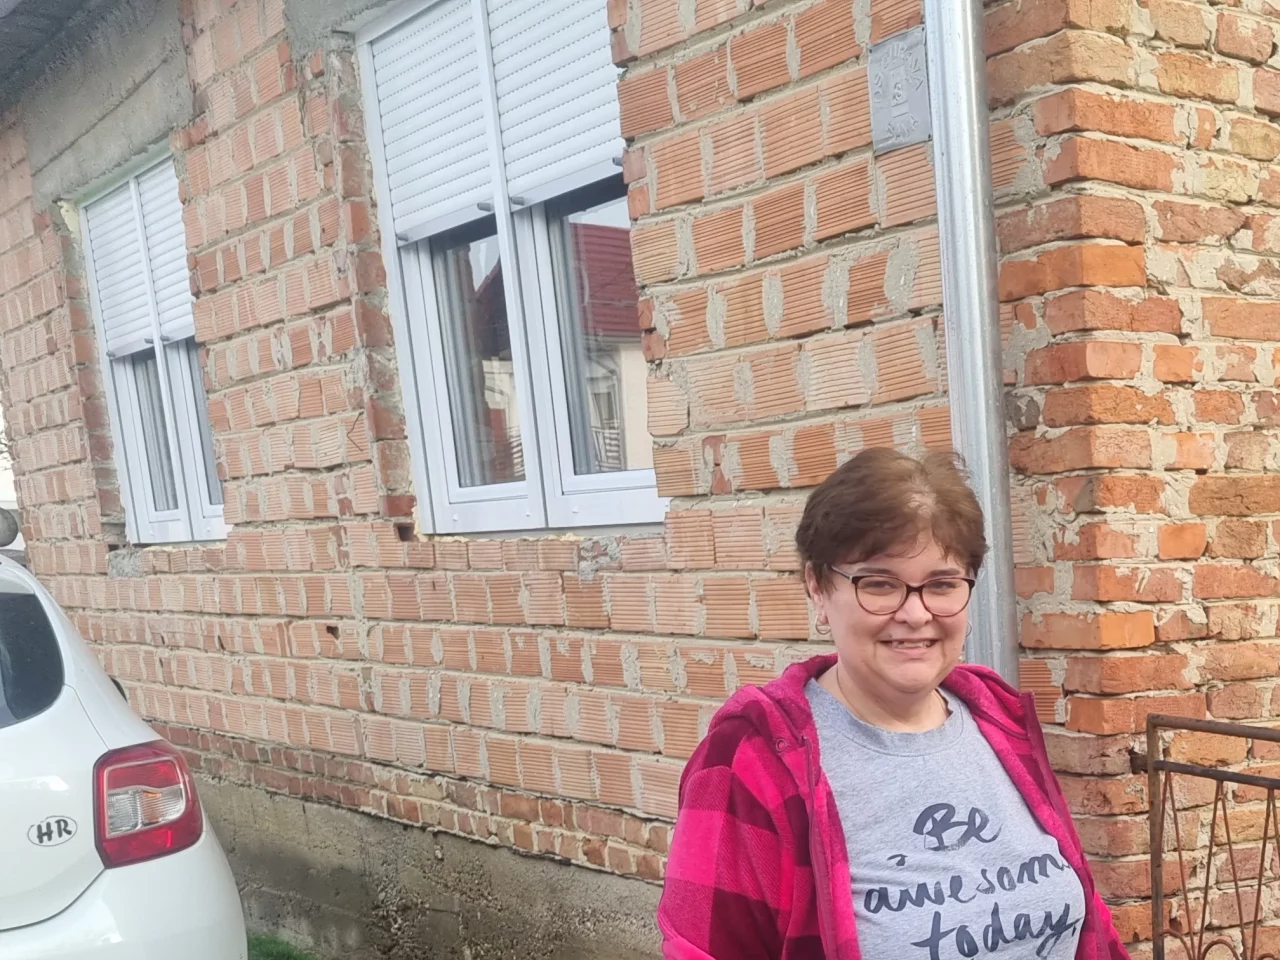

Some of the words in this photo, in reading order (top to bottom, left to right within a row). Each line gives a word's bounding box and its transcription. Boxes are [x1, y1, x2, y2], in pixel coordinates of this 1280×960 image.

[36, 818, 73, 844] HR
[912, 802, 1001, 851] Be
[863, 852, 1071, 914] awesom
